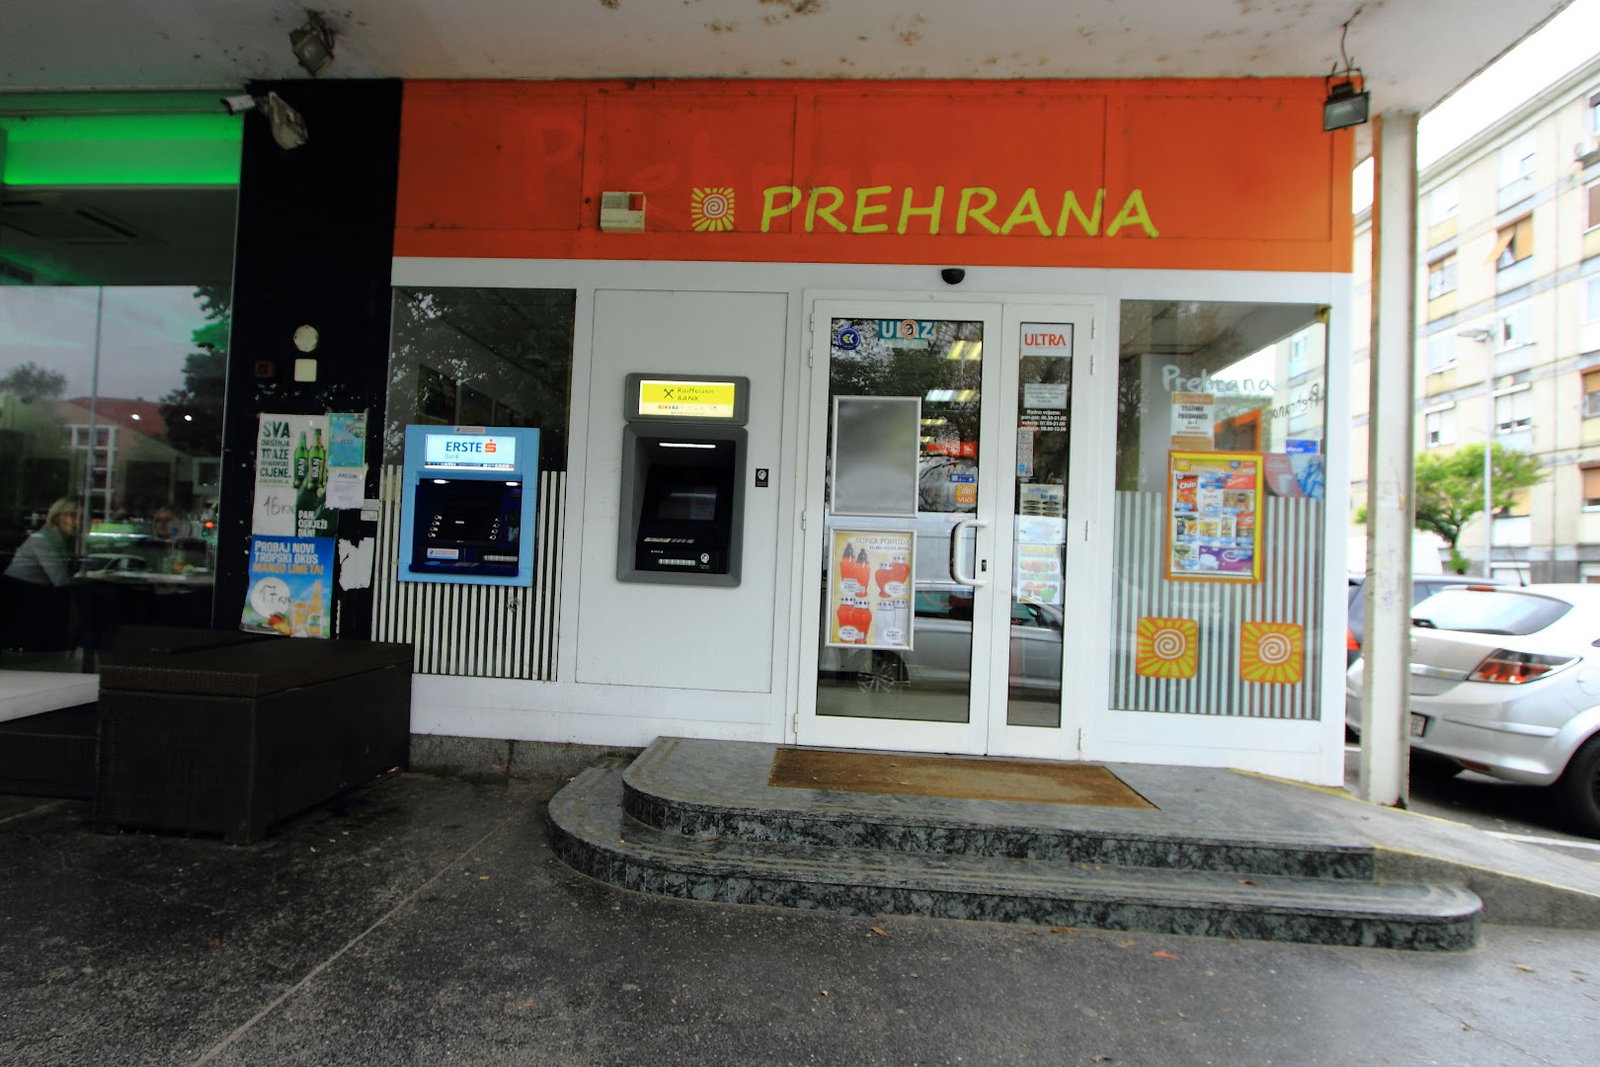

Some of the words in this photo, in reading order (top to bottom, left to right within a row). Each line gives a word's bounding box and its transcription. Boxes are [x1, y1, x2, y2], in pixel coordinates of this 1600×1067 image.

[761, 185, 1159, 237] PREHRANA
[1024, 333, 1066, 346] ULTRA
[263, 421, 290, 438] SVA
[445, 441, 482, 453] ERSTE
[254, 540, 291, 553] PROBAJ
[292, 543, 315, 554] NOVI
[294, 553, 319, 565] OKUS
